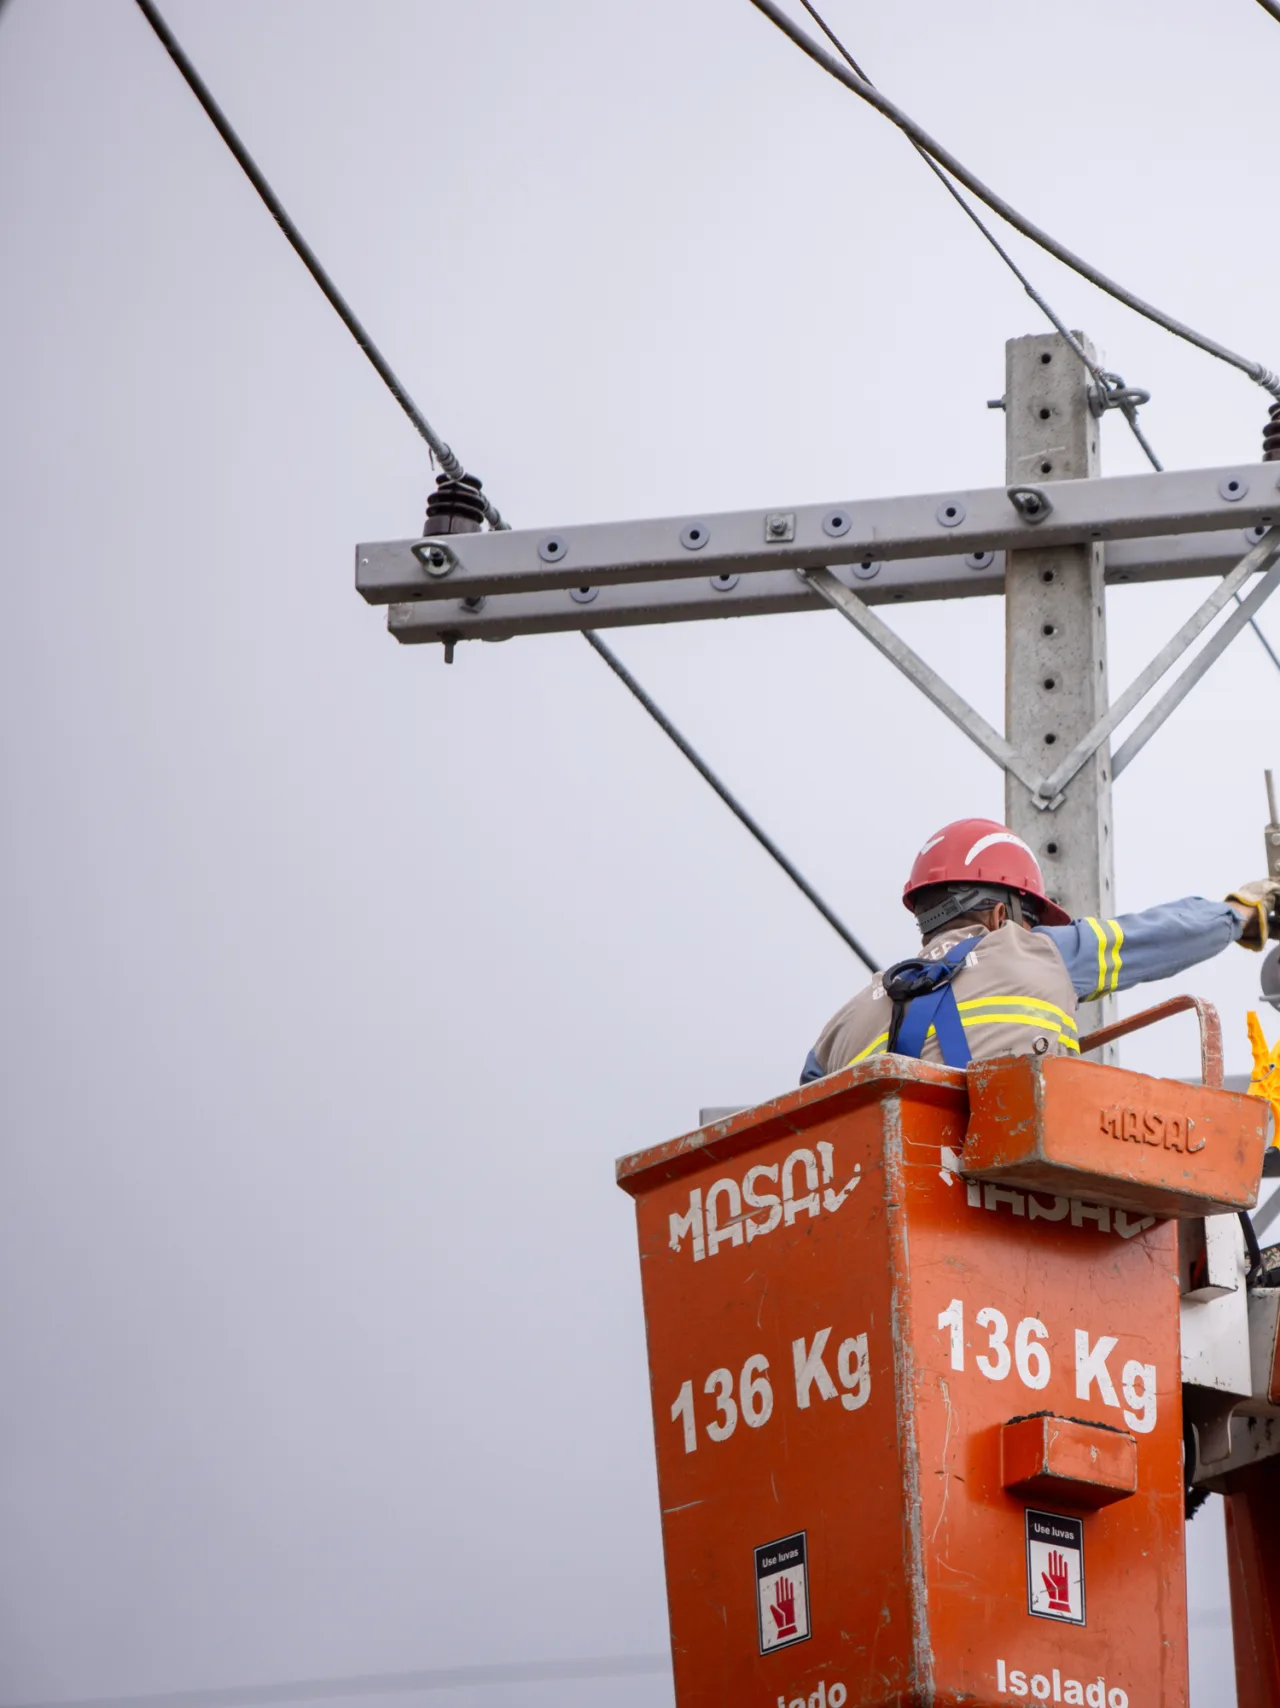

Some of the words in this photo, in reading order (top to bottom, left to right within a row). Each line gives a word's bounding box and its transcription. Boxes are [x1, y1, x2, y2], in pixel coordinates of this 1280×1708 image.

[1100, 1104, 1206, 1154] MASAL
[668, 1140, 861, 1262] MASAL
[671, 1353, 774, 1454] 136
[792, 1326, 872, 1411] Kg
[937, 1298, 1051, 1390] 136
[1074, 1328, 1158, 1434] Kg
[1034, 1523, 1050, 1535] Use
[1052, 1526, 1075, 1540] luvas
[762, 1556, 777, 1568] Use
[778, 1549, 799, 1562] luvas
[997, 1659, 1129, 1708] Isolado
